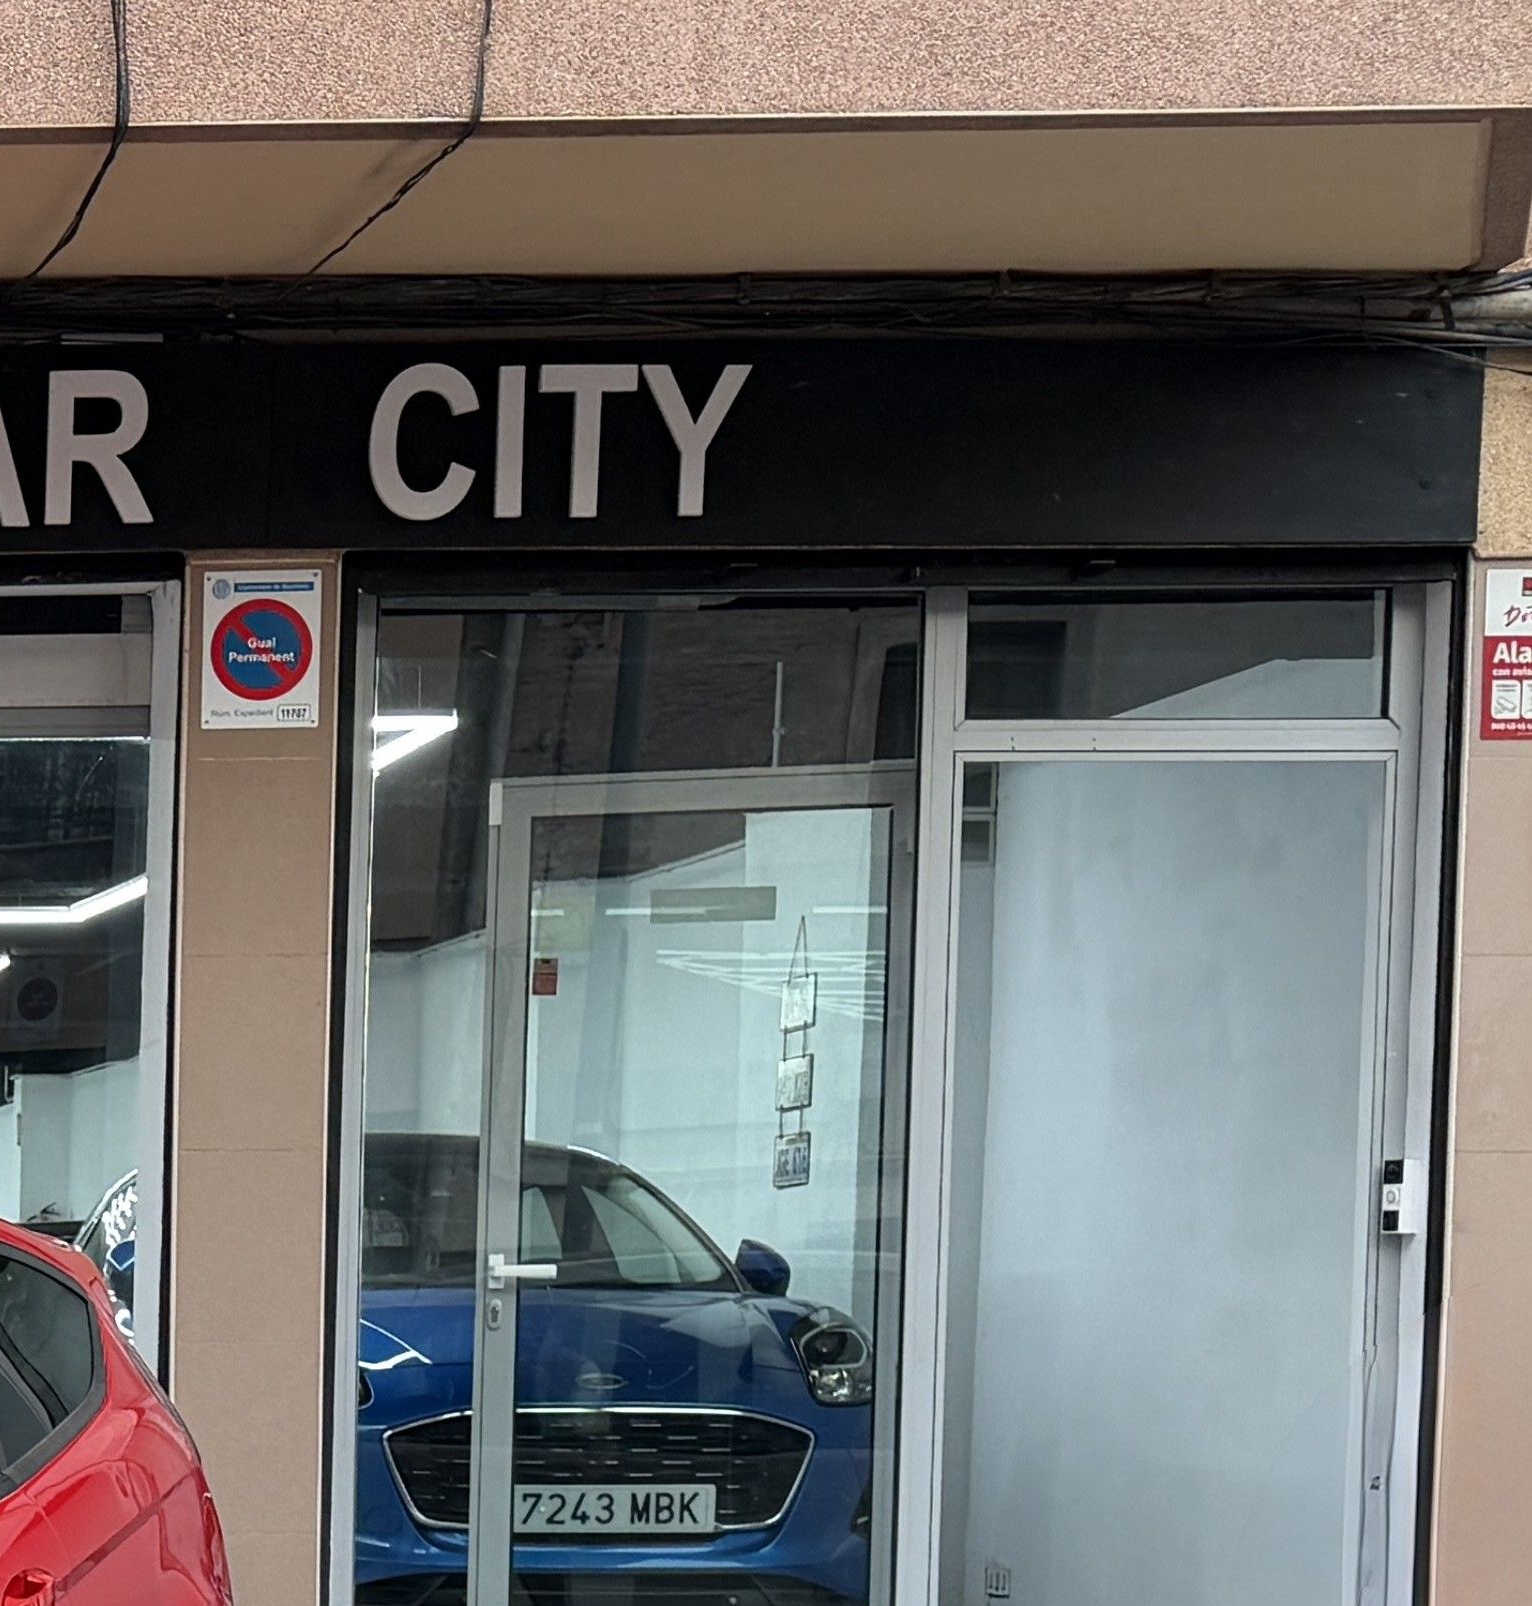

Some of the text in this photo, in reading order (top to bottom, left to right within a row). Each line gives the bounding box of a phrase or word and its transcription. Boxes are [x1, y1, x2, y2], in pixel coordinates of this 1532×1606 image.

[368, 363, 753, 522] CITY
[247, 636, 277, 649] Gual
[228, 651, 296, 664] Permanent
[521, 1492, 700, 1525] 7243 MBK
